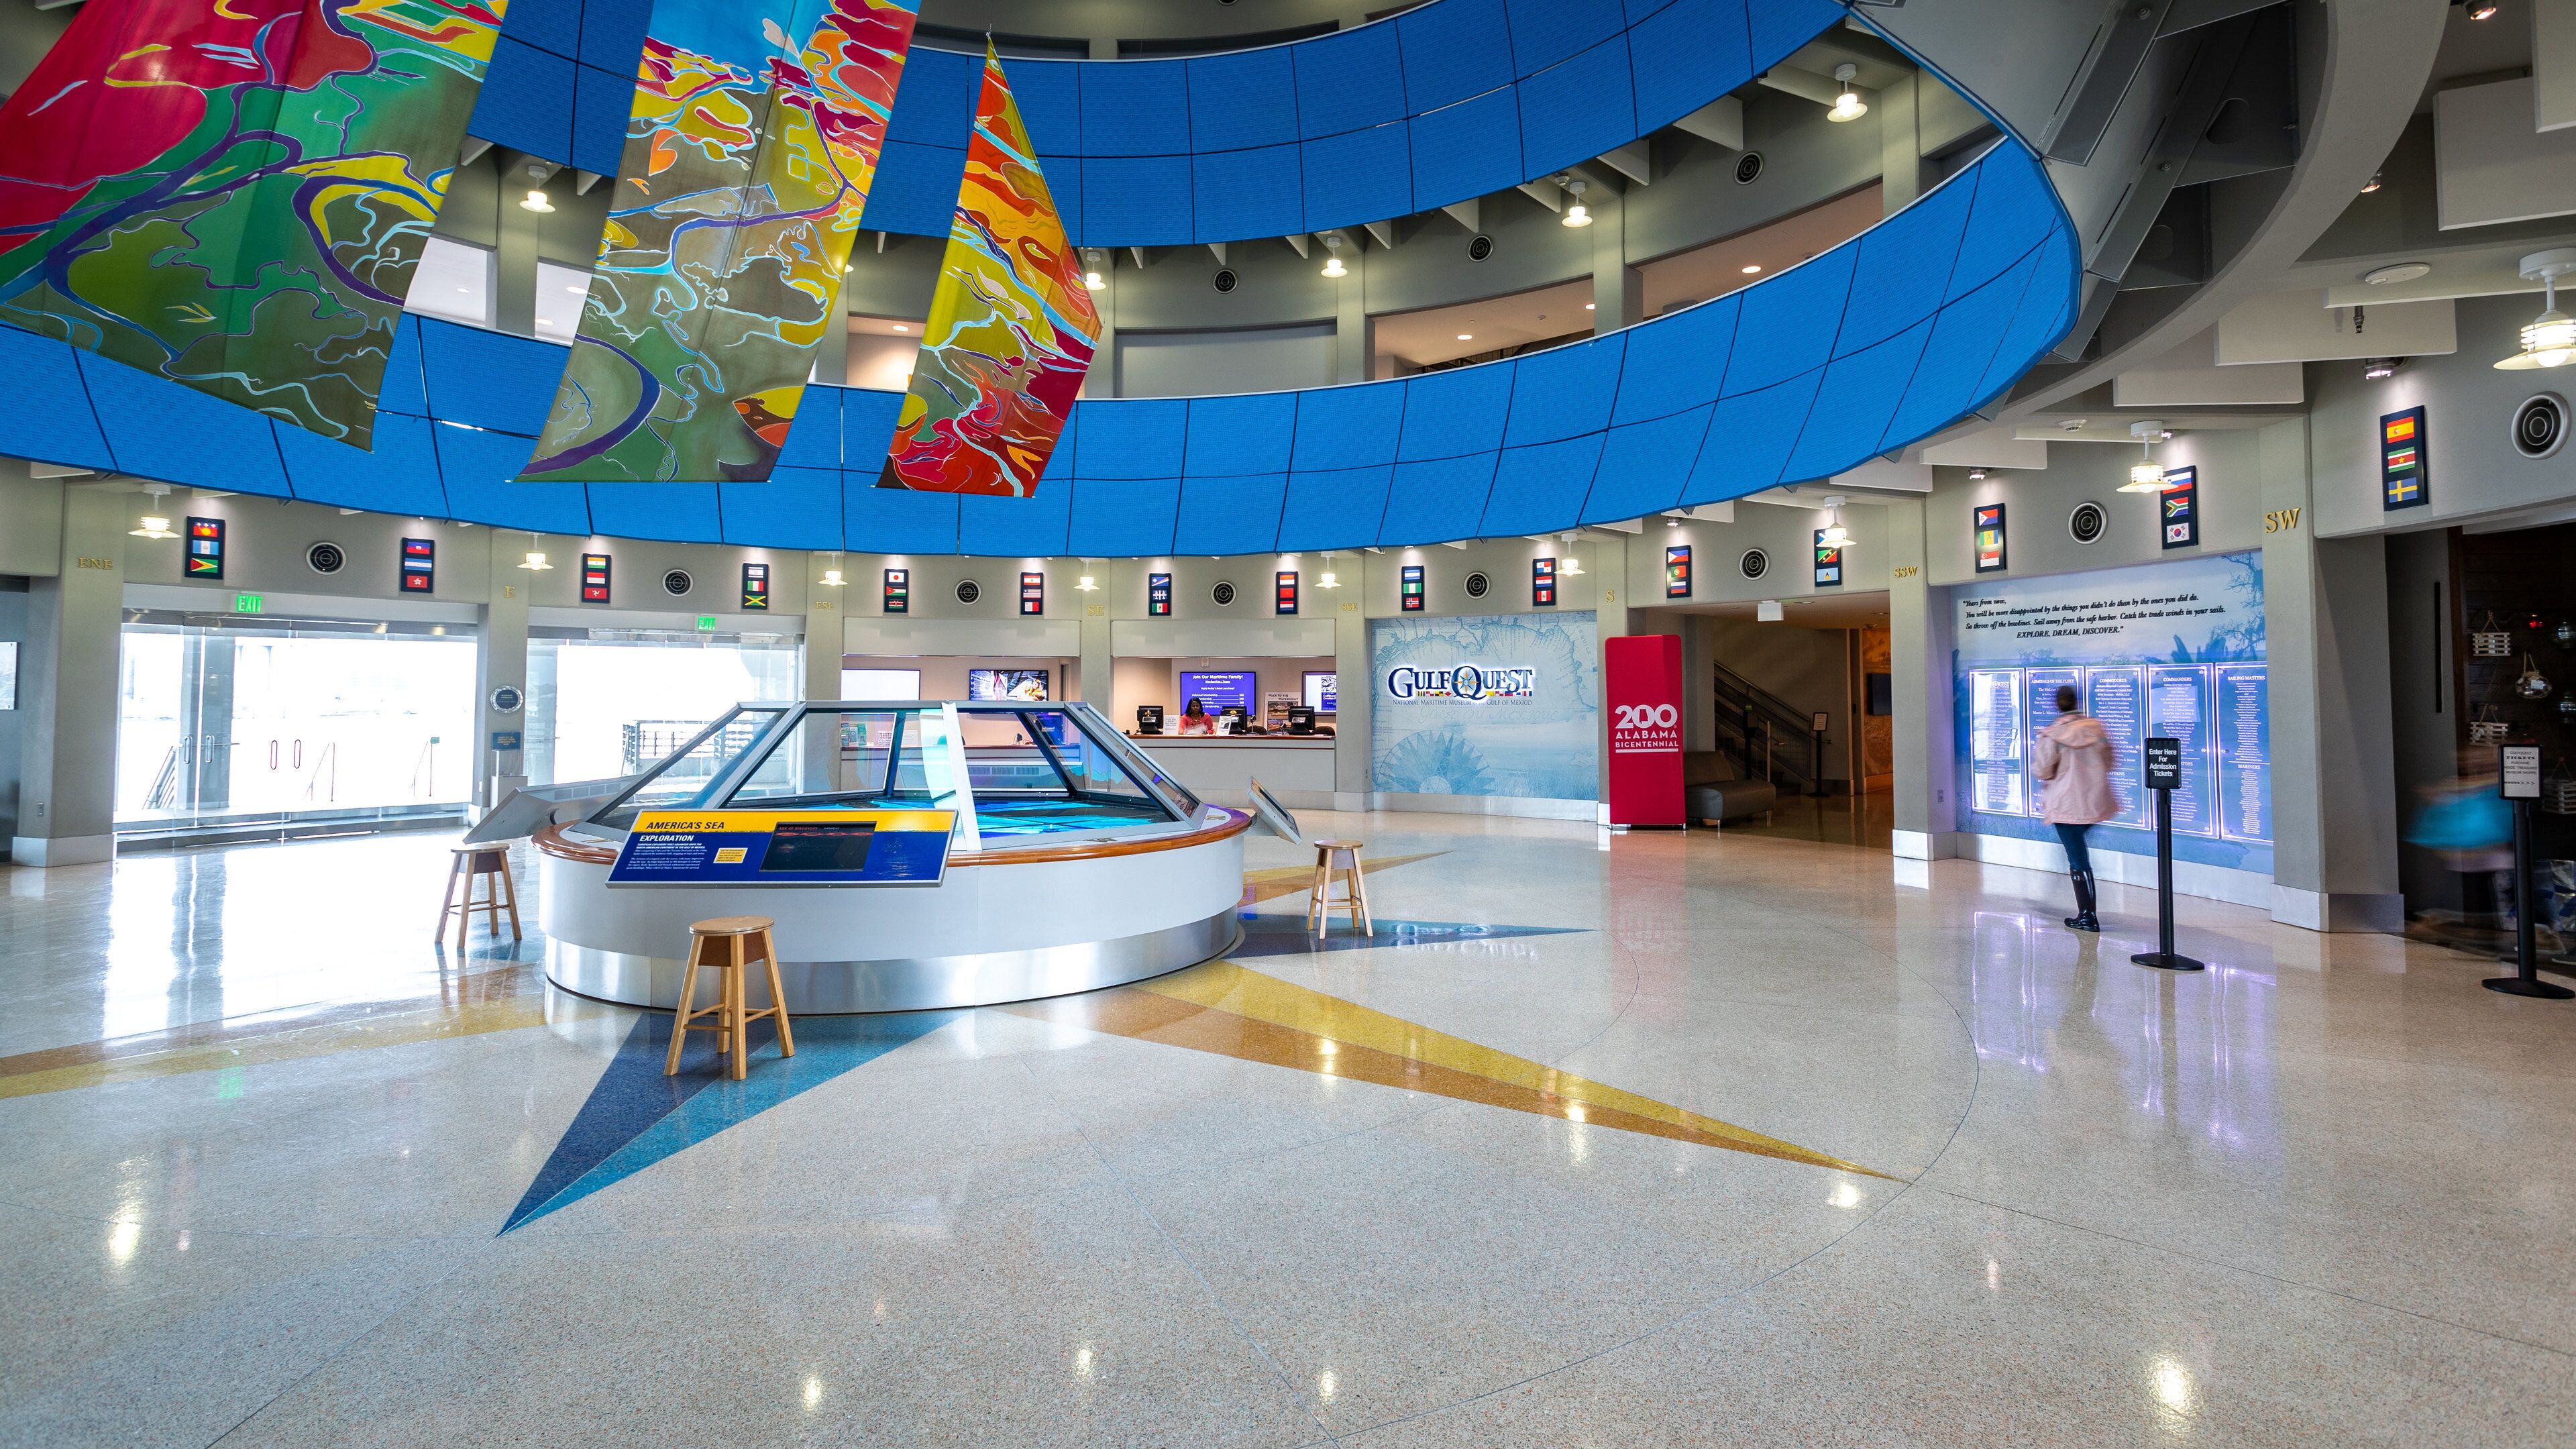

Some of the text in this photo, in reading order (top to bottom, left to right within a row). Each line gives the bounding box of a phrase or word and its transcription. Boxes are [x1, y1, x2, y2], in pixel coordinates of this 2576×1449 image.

[2265, 508, 2300, 533] SW
[78, 557, 113, 570] ENE
[1894, 567, 1917, 578] SSW
[504, 586, 515, 598] E
[1606, 590, 1614, 602] S
[237, 595, 262, 612] EXIT
[815, 601, 834, 610] ESE
[1342, 603, 1358, 611] SSE
[1980, 599, 1992, 607] from
[2010, 606, 2043, 616] disappointed
[2132, 598, 2139, 606] by
[2165, 597, 2176, 605] you
[1088, 605, 1104, 616] SE
[698, 616, 716, 630] EXIT
[1990, 621, 1998, 629] off
[2061, 617, 2074, 625] from
[2086, 616, 2096, 624] safe
[2194, 608, 2208, 616] your
[2210, 605, 2226, 613] sails.
[2017, 630, 2050, 639] EXPLORE,
[2052, 629, 2080, 637] DREAM,
[1615, 704, 1678, 729] 200
[1615, 730, 1677, 739] ALABAMA
